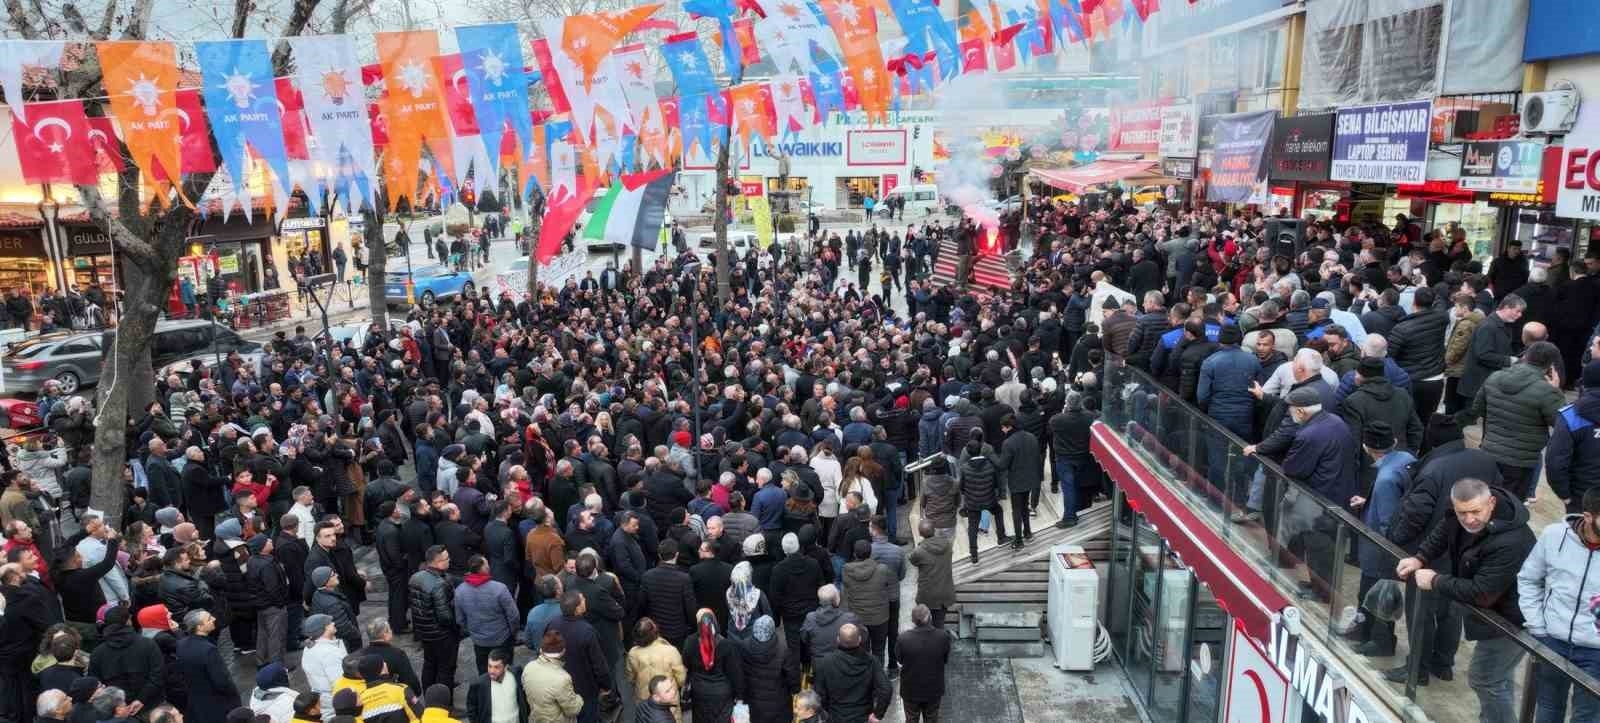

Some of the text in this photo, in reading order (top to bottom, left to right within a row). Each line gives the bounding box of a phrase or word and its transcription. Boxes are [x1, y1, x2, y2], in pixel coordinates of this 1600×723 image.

[402, 104, 414, 113] AK
[321, 112, 335, 121] AK
[1337, 113, 1362, 135] SENA
[1363, 105, 1428, 134] BİLGİSAYAR
[1347, 144, 1376, 160] LAPTOP
[0, 237, 23, 250] ER
